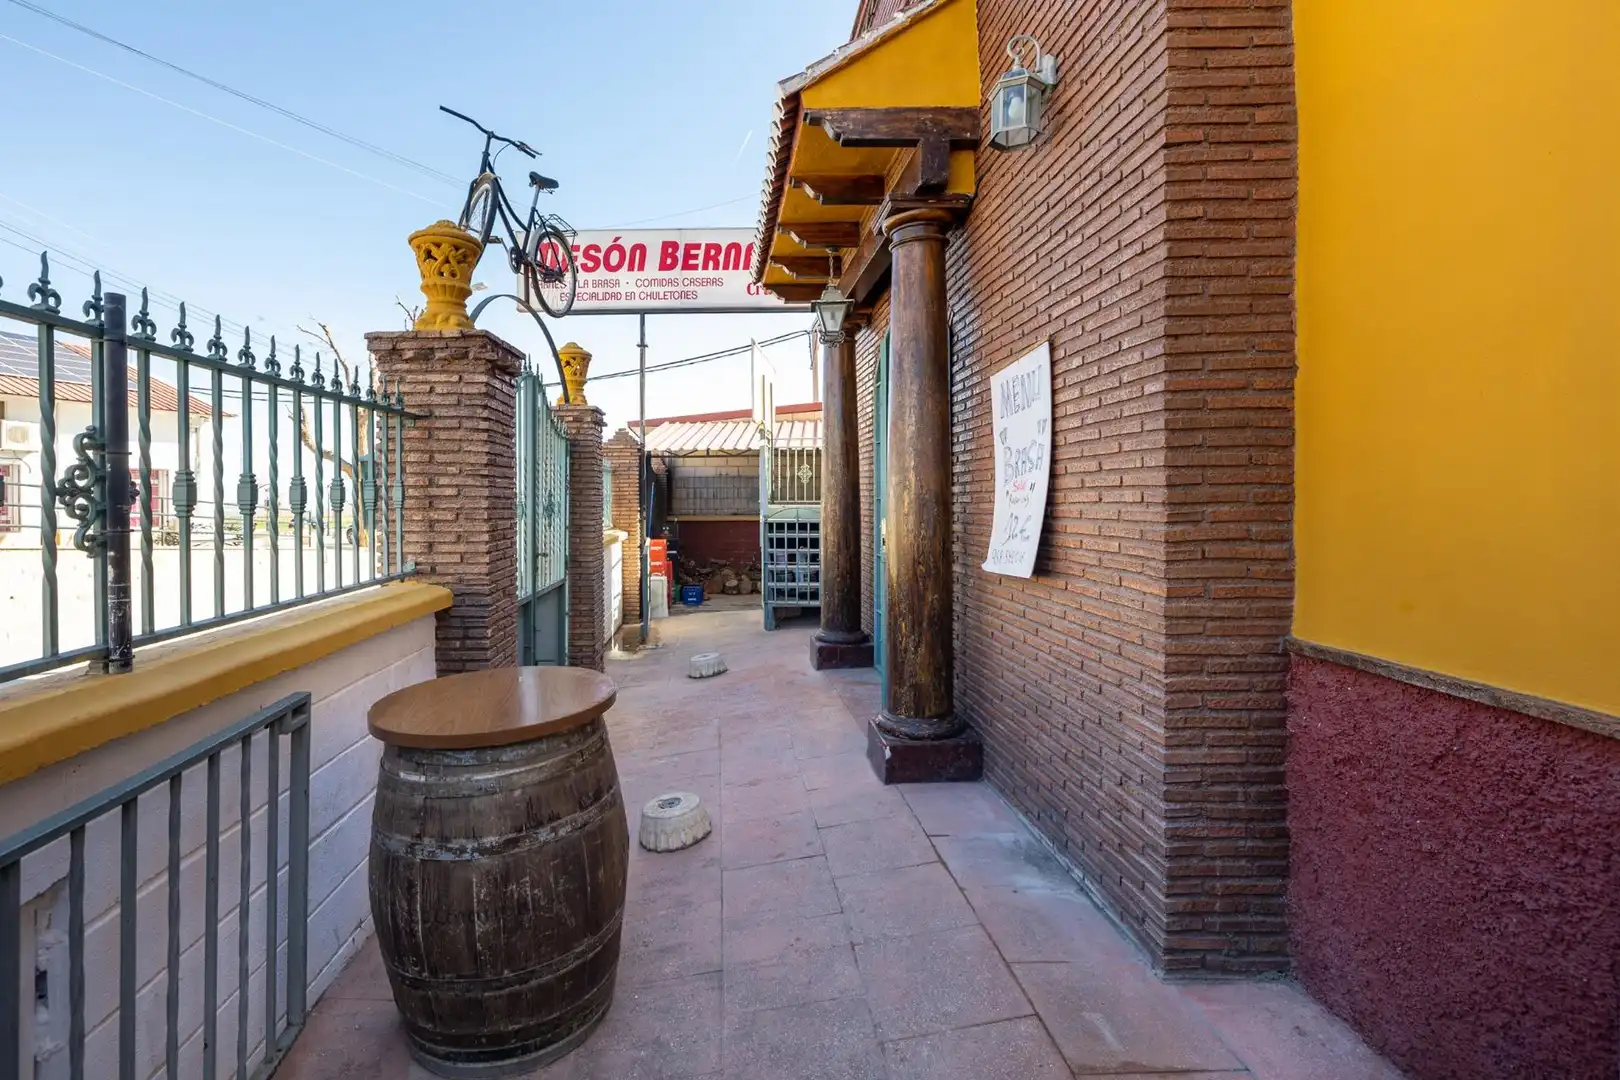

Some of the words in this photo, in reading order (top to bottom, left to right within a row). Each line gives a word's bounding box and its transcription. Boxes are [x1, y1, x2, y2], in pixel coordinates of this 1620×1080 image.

[578, 279, 588, 288] LA
[592, 279, 620, 288] BRASA
[636, 278, 679, 288] COMIDAS
[682, 277, 724, 287] CASERAS
[560, 292, 622, 301] ESECIALIDAD
[625, 292, 635, 301] EN
[639, 290, 698, 300] CHULETONES
